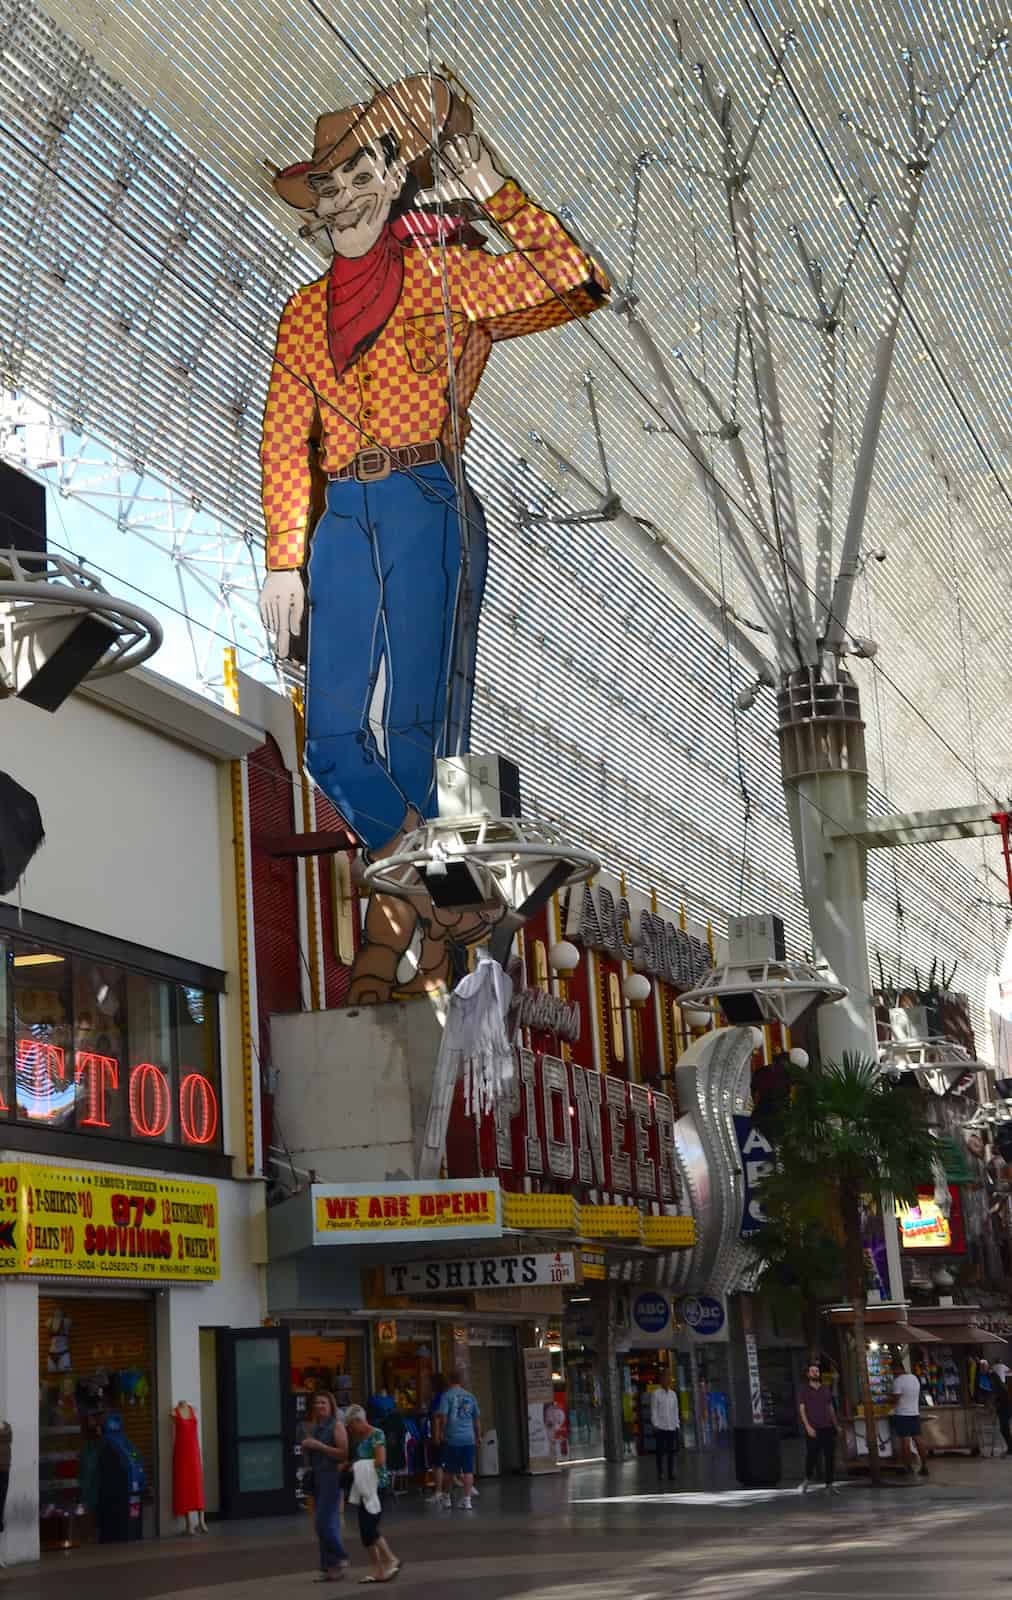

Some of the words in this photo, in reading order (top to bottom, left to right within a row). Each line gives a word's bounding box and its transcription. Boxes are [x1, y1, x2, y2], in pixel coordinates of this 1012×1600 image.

[0, 1037, 217, 1144] TTOO
[35, 1190, 77, 1214] T-SHIRTS
[325, 1198, 359, 1218] WE
[368, 1196, 411, 1218] ARE
[420, 1191, 489, 1216] OPEN!
[35, 1225, 60, 1250] HATS
[392, 1256, 538, 1291] T-SHIRTS
